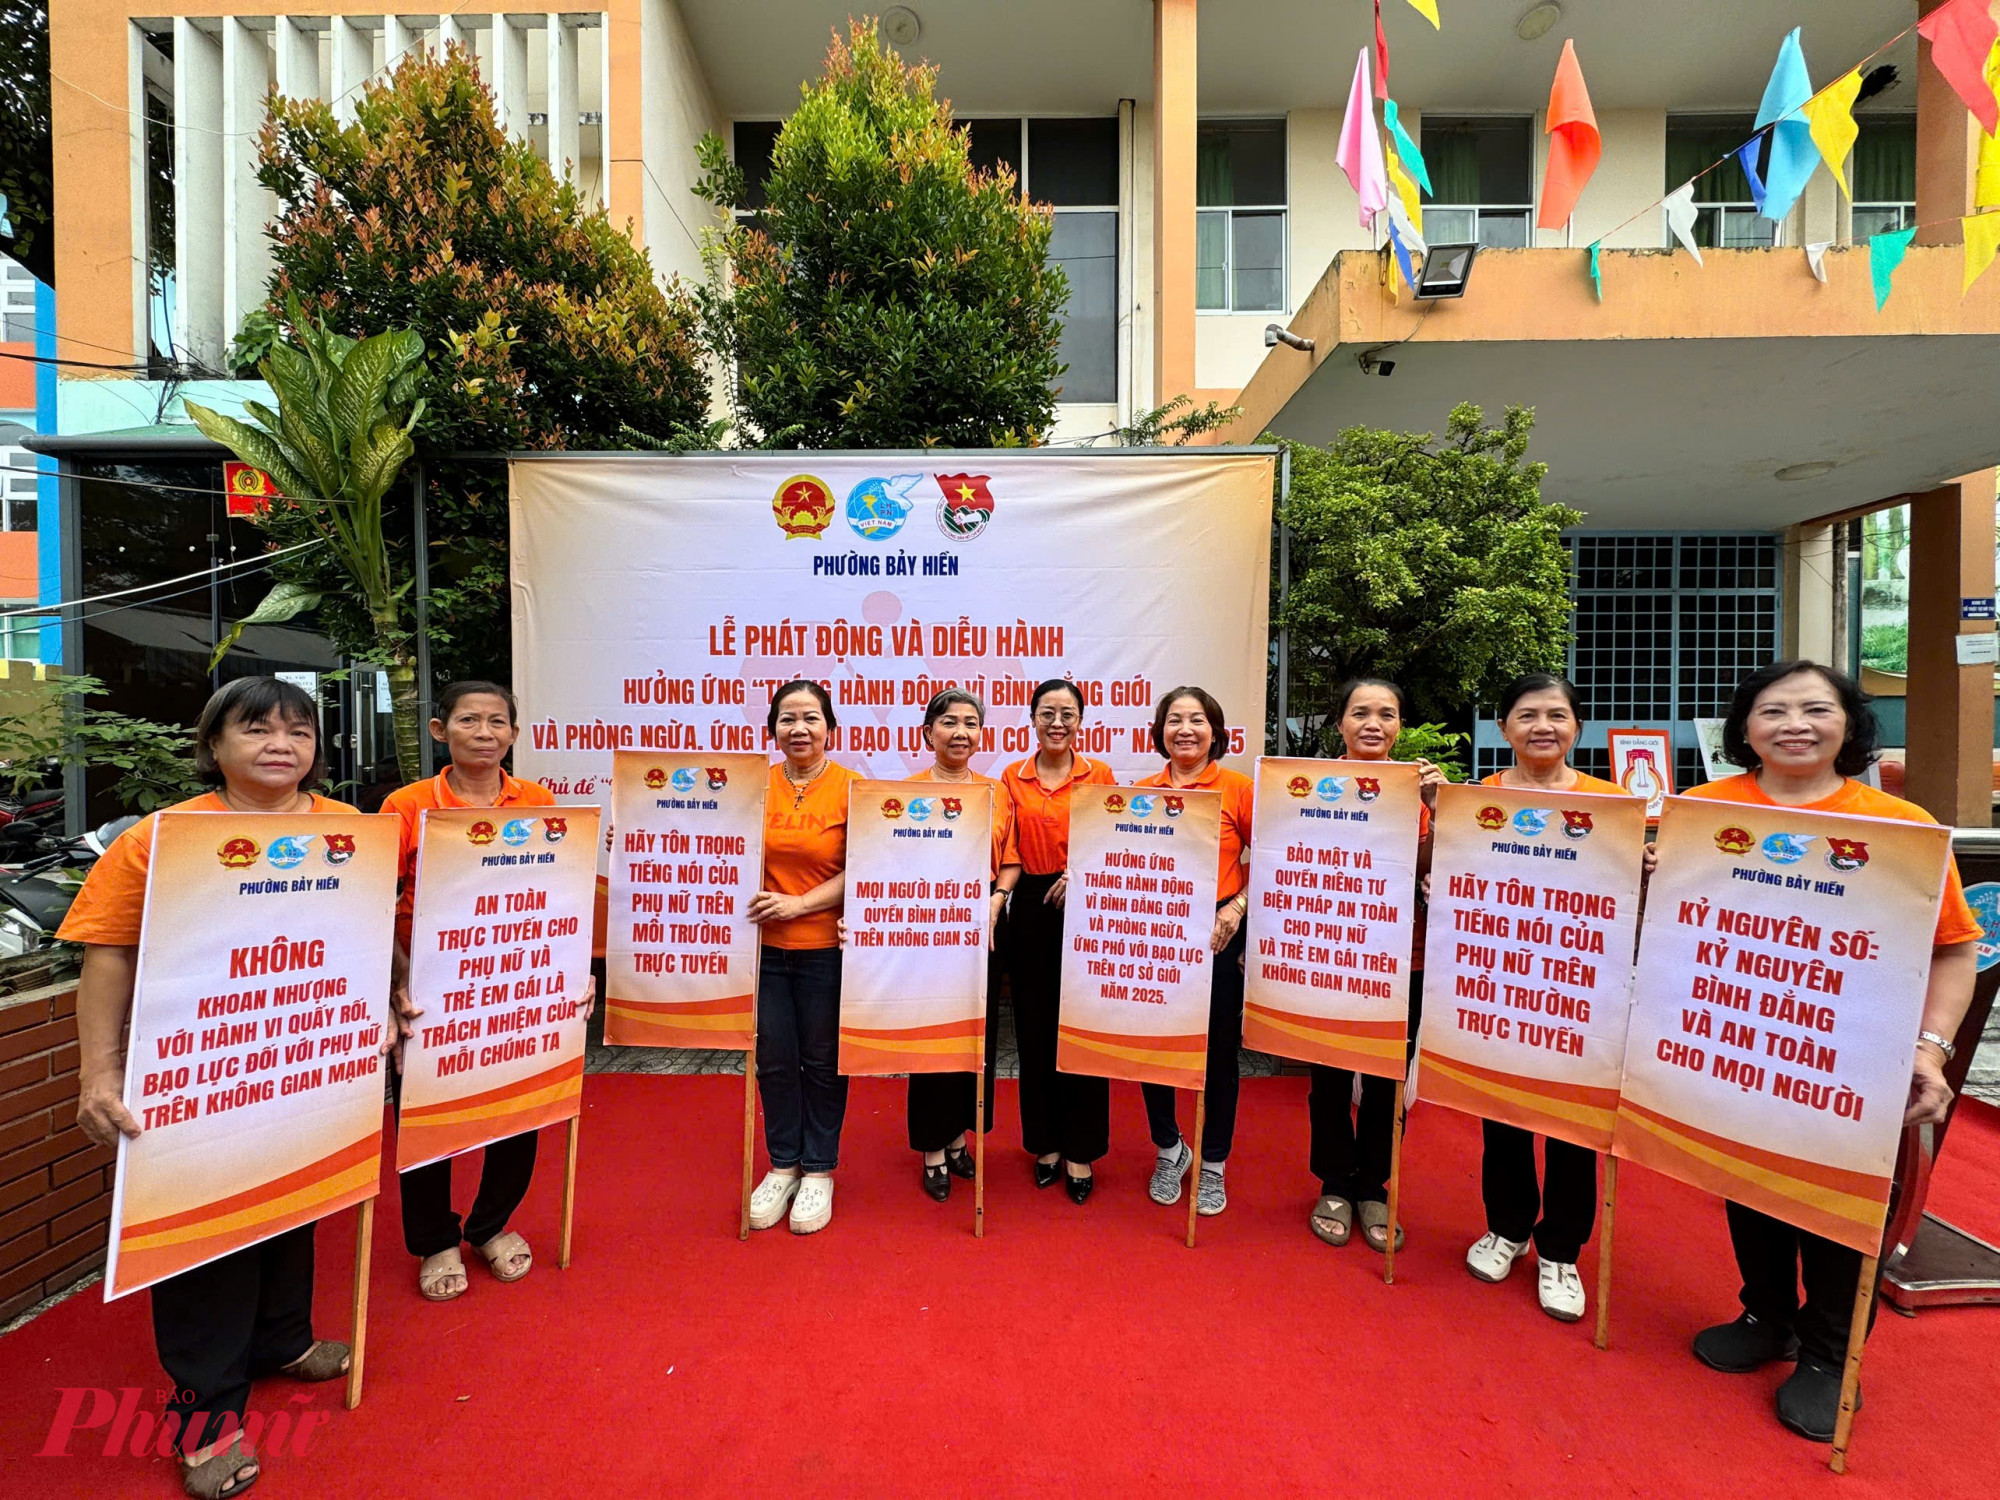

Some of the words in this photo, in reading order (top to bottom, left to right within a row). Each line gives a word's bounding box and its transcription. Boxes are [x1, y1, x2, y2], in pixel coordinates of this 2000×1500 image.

[813, 550, 880, 576] PHƯỜNG
[886, 549, 917, 576] BẢY
[922, 551, 958, 576] HIỀN
[709, 615, 736, 656] LỄ
[745, 618, 807, 656] PHÁT
[816, 618, 882, 663] ĐỘNG
[891, 618, 924, 656] VÀ
[933, 616, 987, 657] DIỄU
[996, 618, 1064, 657] HÀNH
[624, 669, 694, 705] HƯỞNG
[702, 673, 745, 705] ỨNG
[839, 673, 895, 706] HÀNH
[1111, 674, 1151, 707] GIỚI
[532, 718, 559, 750] VÀ
[566, 718, 633, 750] PHÒNG
[710, 719, 754, 751] ỨNG
[850, 726, 890, 757] BẠO
[1002, 725, 1030, 753] CƠ
[574, 775, 597, 795] đề
[625, 829, 655, 853] HÃY
[661, 829, 690, 854] TÔN
[696, 835, 745, 859] TRỌNG
[1287, 842, 1313, 863] BẢO
[1318, 848, 1348, 869] MẬT
[1354, 849, 1372, 869] VÀ
[1492, 842, 1530, 856] PHƯỜNG
[1533, 844, 1552, 858] BẢY
[678, 861, 703, 884] NÓI
[709, 860, 738, 885] CỦA
[1105, 849, 1145, 869] HƯỞNG
[1150, 853, 1175, 872] ỨNG
[239, 879, 287, 895] PHƯỜNG
[291, 877, 312, 892] BẢY
[856, 882, 883, 902] MỌI
[889, 878, 930, 899] NGƯỜI
[964, 880, 981, 899] CÓ
[1085, 872, 1122, 889] THÁNG
[1126, 874, 1157, 892] HÀNH
[1162, 877, 1193, 899] ĐỘNG
[1323, 872, 1363, 893] RIÊNG
[1732, 867, 1782, 886] PHƯỜNG
[1785, 874, 1811, 891] BẢY
[474, 895, 499, 916] AN
[505, 888, 547, 912] TOÀN
[633, 893, 662, 916] PHỤ
[668, 890, 691, 914] NỮ
[695, 891, 733, 914] TRÊN
[1086, 894, 1096, 909] VÌ
[1101, 895, 1127, 912] BÌNH
[1263, 890, 1291, 913] BIỆN
[1297, 895, 1332, 915] PHÁP
[1337, 901, 1355, 918] AN
[1361, 901, 1398, 923] TOÀN
[1449, 873, 1488, 900] HÃY
[1496, 878, 1535, 907] TÔN
[1543, 888, 1616, 920] TRỌNG
[908, 904, 935, 923] BÌNH
[1089, 915, 1103, 932] VÀ
[1108, 918, 1146, 936] PHÒNG
[438, 927, 486, 952] TRỰC
[492, 918, 542, 945] TUYẾN
[548, 917, 578, 937] CHO
[633, 919, 664, 943] MÔI
[670, 920, 731, 944] TRƯỜNG
[854, 928, 884, 947] TRÊN
[888, 928, 929, 947] KHÔNG
[933, 931, 960, 946] GIAN
[964, 928, 981, 946] SỐ
[1284, 919, 1310, 936] CHO
[1315, 923, 1342, 944] PHỤ
[1347, 924, 1367, 944] NỮ
[1454, 907, 1509, 938] TIẾNG
[1517, 915, 1552, 945] NÓI
[1560, 921, 1604, 954] CỦA
[1678, 897, 1710, 927] KỶ
[1717, 909, 1821, 951] NGUYÊN
[1829, 929, 1880, 961] SỐ:
[229, 935, 325, 979] KHÔNG
[459, 958, 494, 980] PHỤ
[500, 948, 526, 972] NỮ
[531, 945, 551, 967] VÀ
[634, 952, 675, 977] TRỰC
[1088, 957, 1115, 977] TRÊN
[1259, 936, 1276, 956] VÀ
[1308, 946, 1329, 964] EM
[1334, 948, 1357, 967] GÁI
[1362, 952, 1398, 974] TRÊN
[1456, 943, 1496, 974] PHỤ
[1503, 948, 1535, 976] NỮ
[1541, 957, 1596, 989] TRÊN
[1696, 937, 1729, 967] KỶ
[1735, 949, 1843, 996] NGUYÊN
[443, 984, 475, 1014] TRẺ
[481, 984, 508, 1007] EM
[514, 976, 540, 999] GÁI
[546, 971, 565, 994] LÀ
[1101, 982, 1128, 1000] NĂM
[1262, 962, 1306, 985] KHÔNG
[1311, 971, 1342, 991] GIAN
[1347, 977, 1391, 999] MẠNG
[198, 990, 267, 1020] KHOAN
[274, 977, 347, 1007] NHƯỢNG
[340, 998, 371, 1023] RỐI,
[1456, 974, 1496, 1003] MÔI
[1503, 984, 1591, 1024] TRƯỜNG
[1692, 974, 1751, 1012] BÌNH
[1759, 989, 1835, 1034] ĐẲNG
[265, 1017, 282, 1039] VI
[289, 1005, 334, 1035] QUẤY
[422, 1019, 481, 1049] TRÁCH
[487, 1006, 541, 1036] NHIỆM
[546, 997, 577, 1023] CỦA
[1457, 1008, 1510, 1040] TRỰC
[1517, 1021, 1584, 1058] TUYẾN
[201, 1023, 257, 1051] HÀNH
[285, 1038, 313, 1064] VỚI
[1682, 1008, 1712, 1039] VÀ
[1720, 1021, 1756, 1051] AN
[1765, 1031, 1837, 1074] TOÀN
[142, 1067, 188, 1097] BẠO
[197, 1056, 239, 1086] LỰC
[245, 1045, 277, 1074] ĐỐI
[285, 1038, 313, 1062] VỚI
[320, 1031, 351, 1057] PHỤ
[358, 1025, 381, 1048] NỮ
[437, 1046, 474, 1078] MỖI
[480, 1037, 536, 1067] CHÚNG
[542, 1032, 560, 1050] TA
[142, 1097, 198, 1131] TRÊN
[206, 1082, 273, 1115] KHÔNG
[281, 1068, 322, 1096] GIAN
[328, 1055, 378, 1084] MẠNG
[1657, 1038, 1705, 1071] CHO
[1712, 1054, 1765, 1093] MỌI
[1773, 1072, 1864, 1122] NGƯỜI
